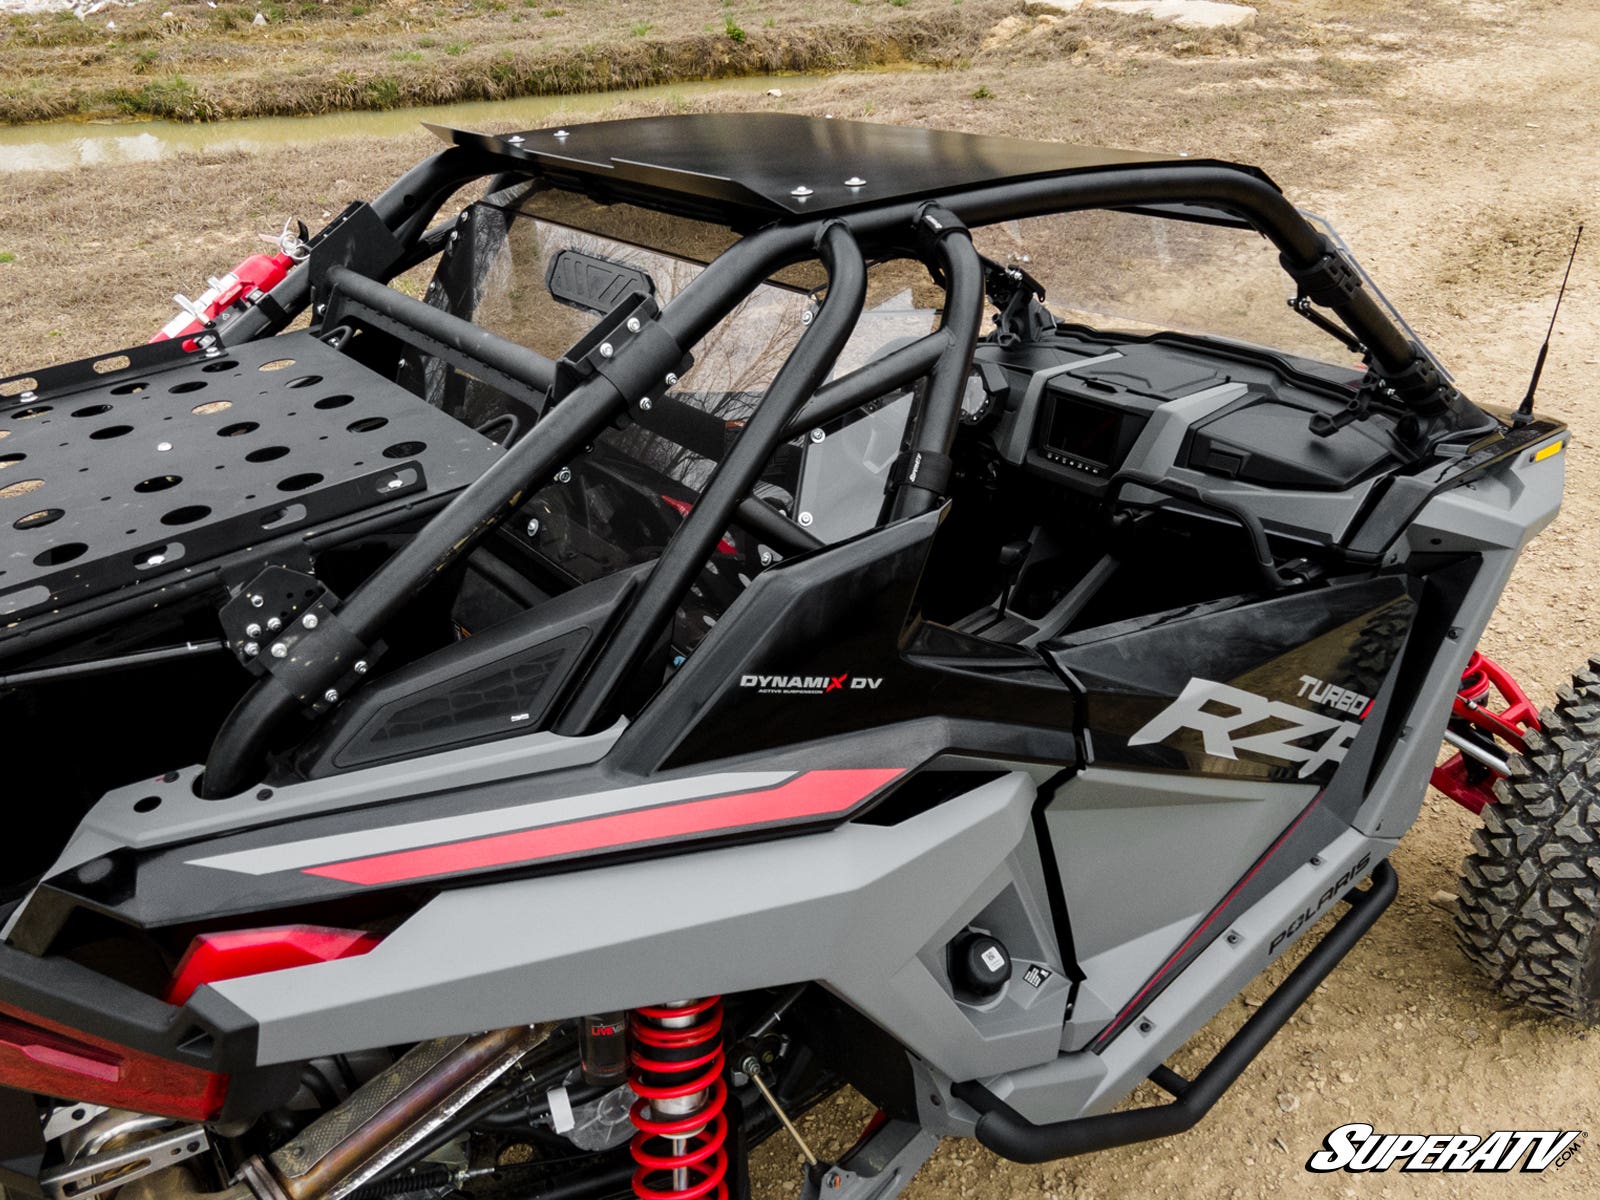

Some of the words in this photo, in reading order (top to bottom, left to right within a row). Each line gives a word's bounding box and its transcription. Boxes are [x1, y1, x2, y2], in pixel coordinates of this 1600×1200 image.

[740, 673, 848, 692] DYNAMIX
[850, 678, 883, 689] DV
[1297, 674, 1371, 716] TURBO
[1268, 851, 1371, 956] POLARIS
